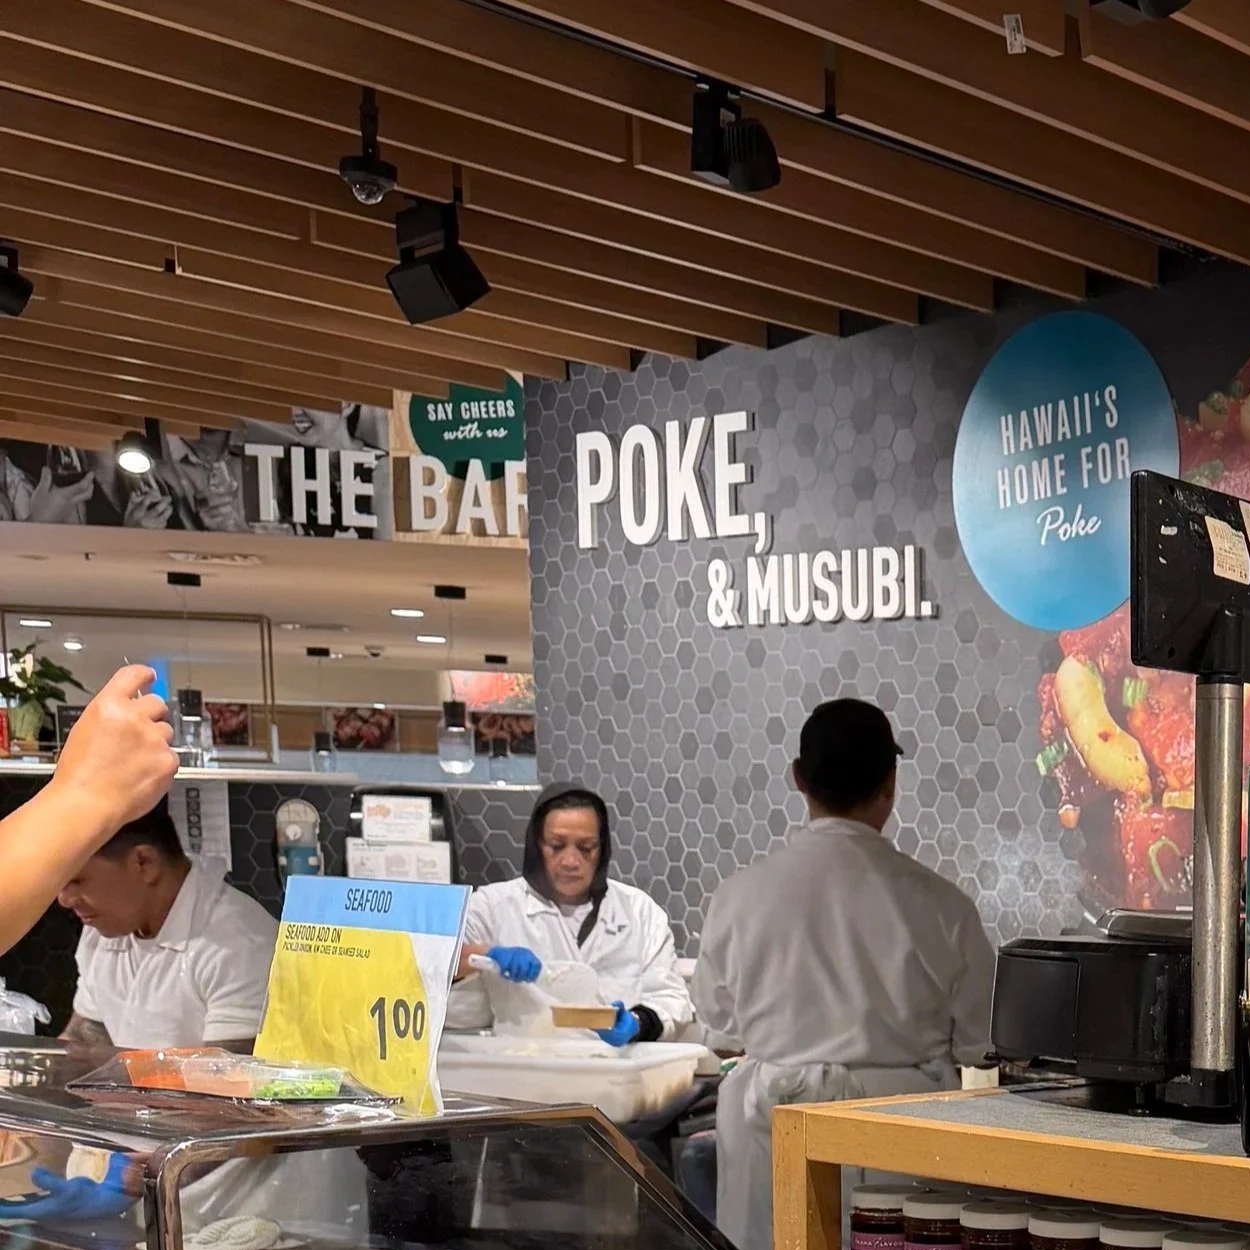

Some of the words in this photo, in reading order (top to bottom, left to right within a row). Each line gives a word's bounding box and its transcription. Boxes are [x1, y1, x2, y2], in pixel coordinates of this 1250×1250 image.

[427, 402, 453, 421] SAY
[460, 400, 515, 419] CHEERS
[443, 422, 482, 440] with
[486, 426, 508, 438] us
[245, 444, 379, 529] THE
[577, 411, 770, 553] POKE,
[997, 454, 1066, 509] HOME
[1082, 437, 1131, 488] FOR
[1036, 504, 1101, 546] Poke
[707, 559, 740, 628] &
[747, 545, 932, 625] MUSUBI.
[345, 888, 393, 914] SEAFOOD
[285, 924, 316, 941] SEAFOOD
[316, 927, 330, 943] ADD
[331, 928, 342, 944] ON
